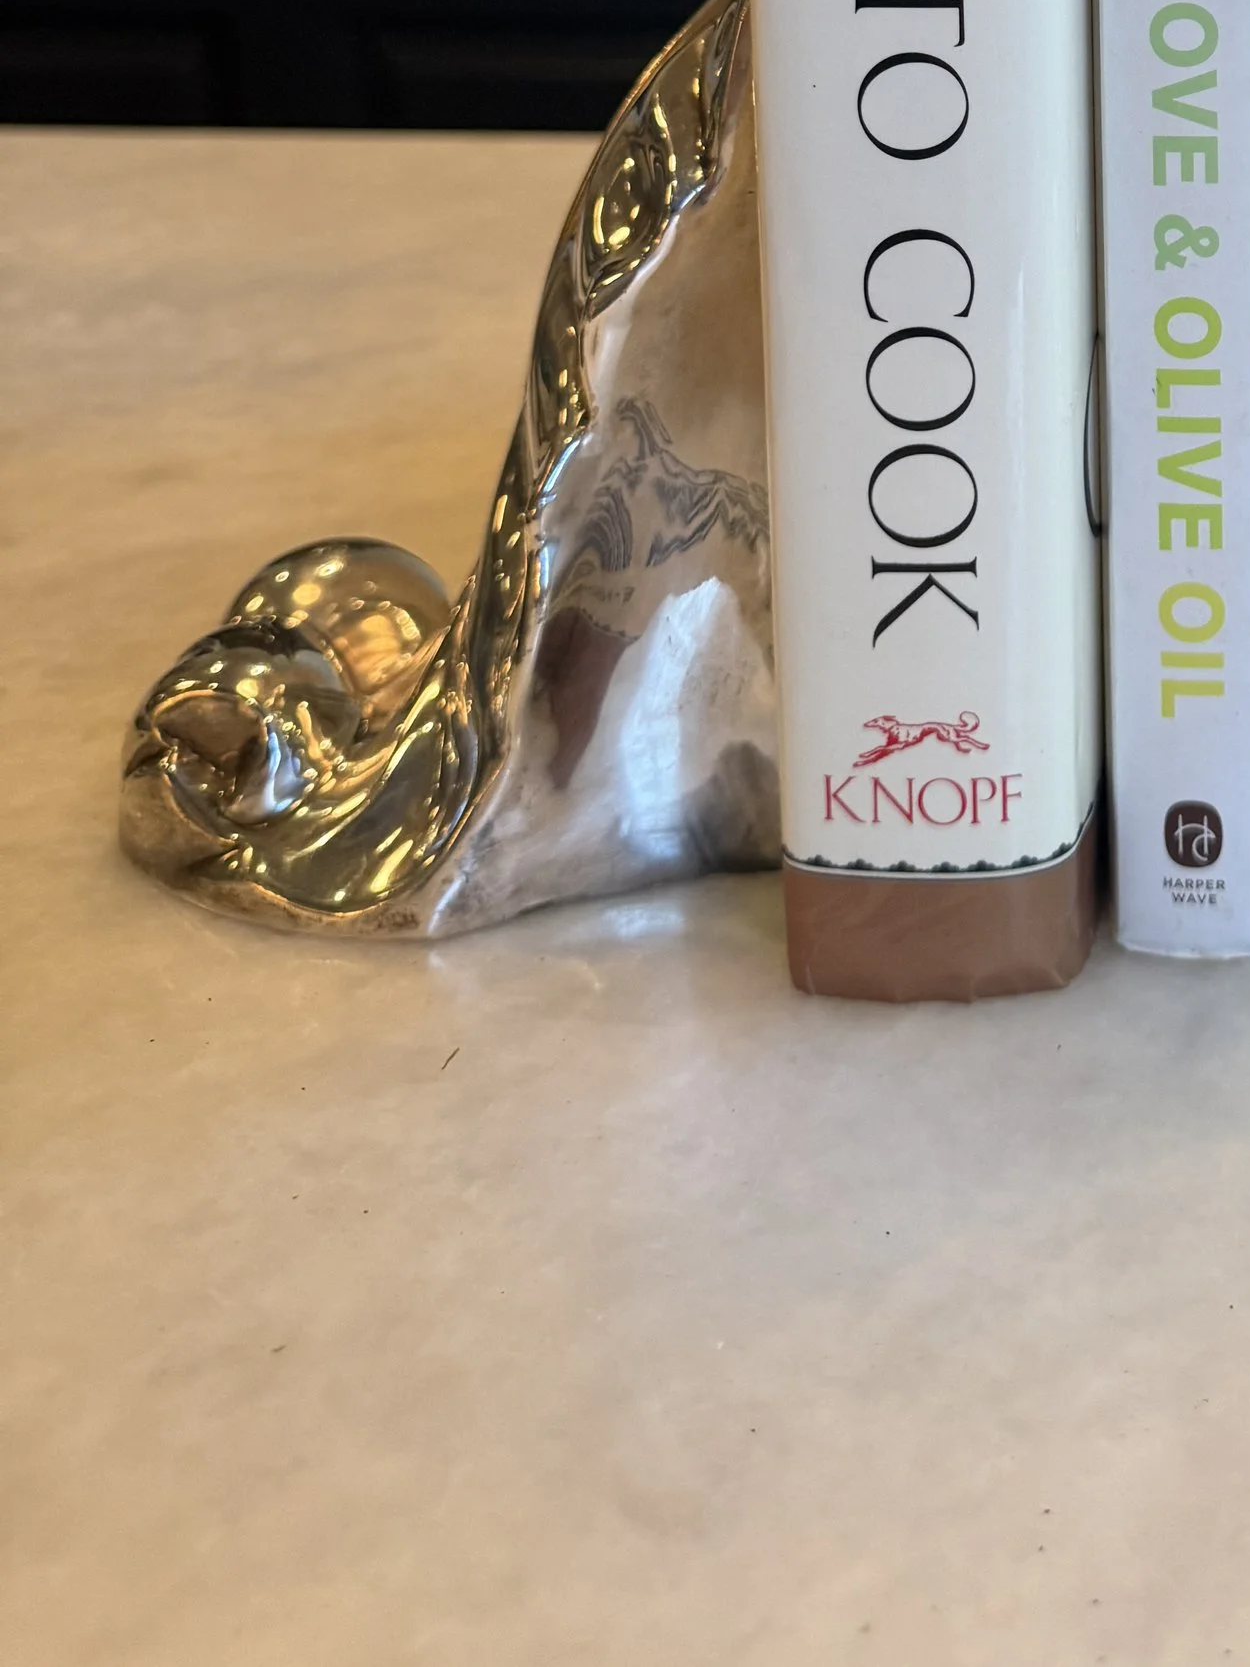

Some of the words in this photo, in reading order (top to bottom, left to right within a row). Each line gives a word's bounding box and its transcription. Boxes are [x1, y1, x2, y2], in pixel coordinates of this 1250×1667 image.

[1153, 214, 1221, 271] &
[863, 229, 980, 650] COOK
[1153, 296, 1223, 551] OLIVE
[1158, 582, 1226, 718] OIL
[823, 773, 1023, 826] KNOPF
[1163, 877, 1226, 890] HARPER
[1172, 892, 1218, 905] WAVE
